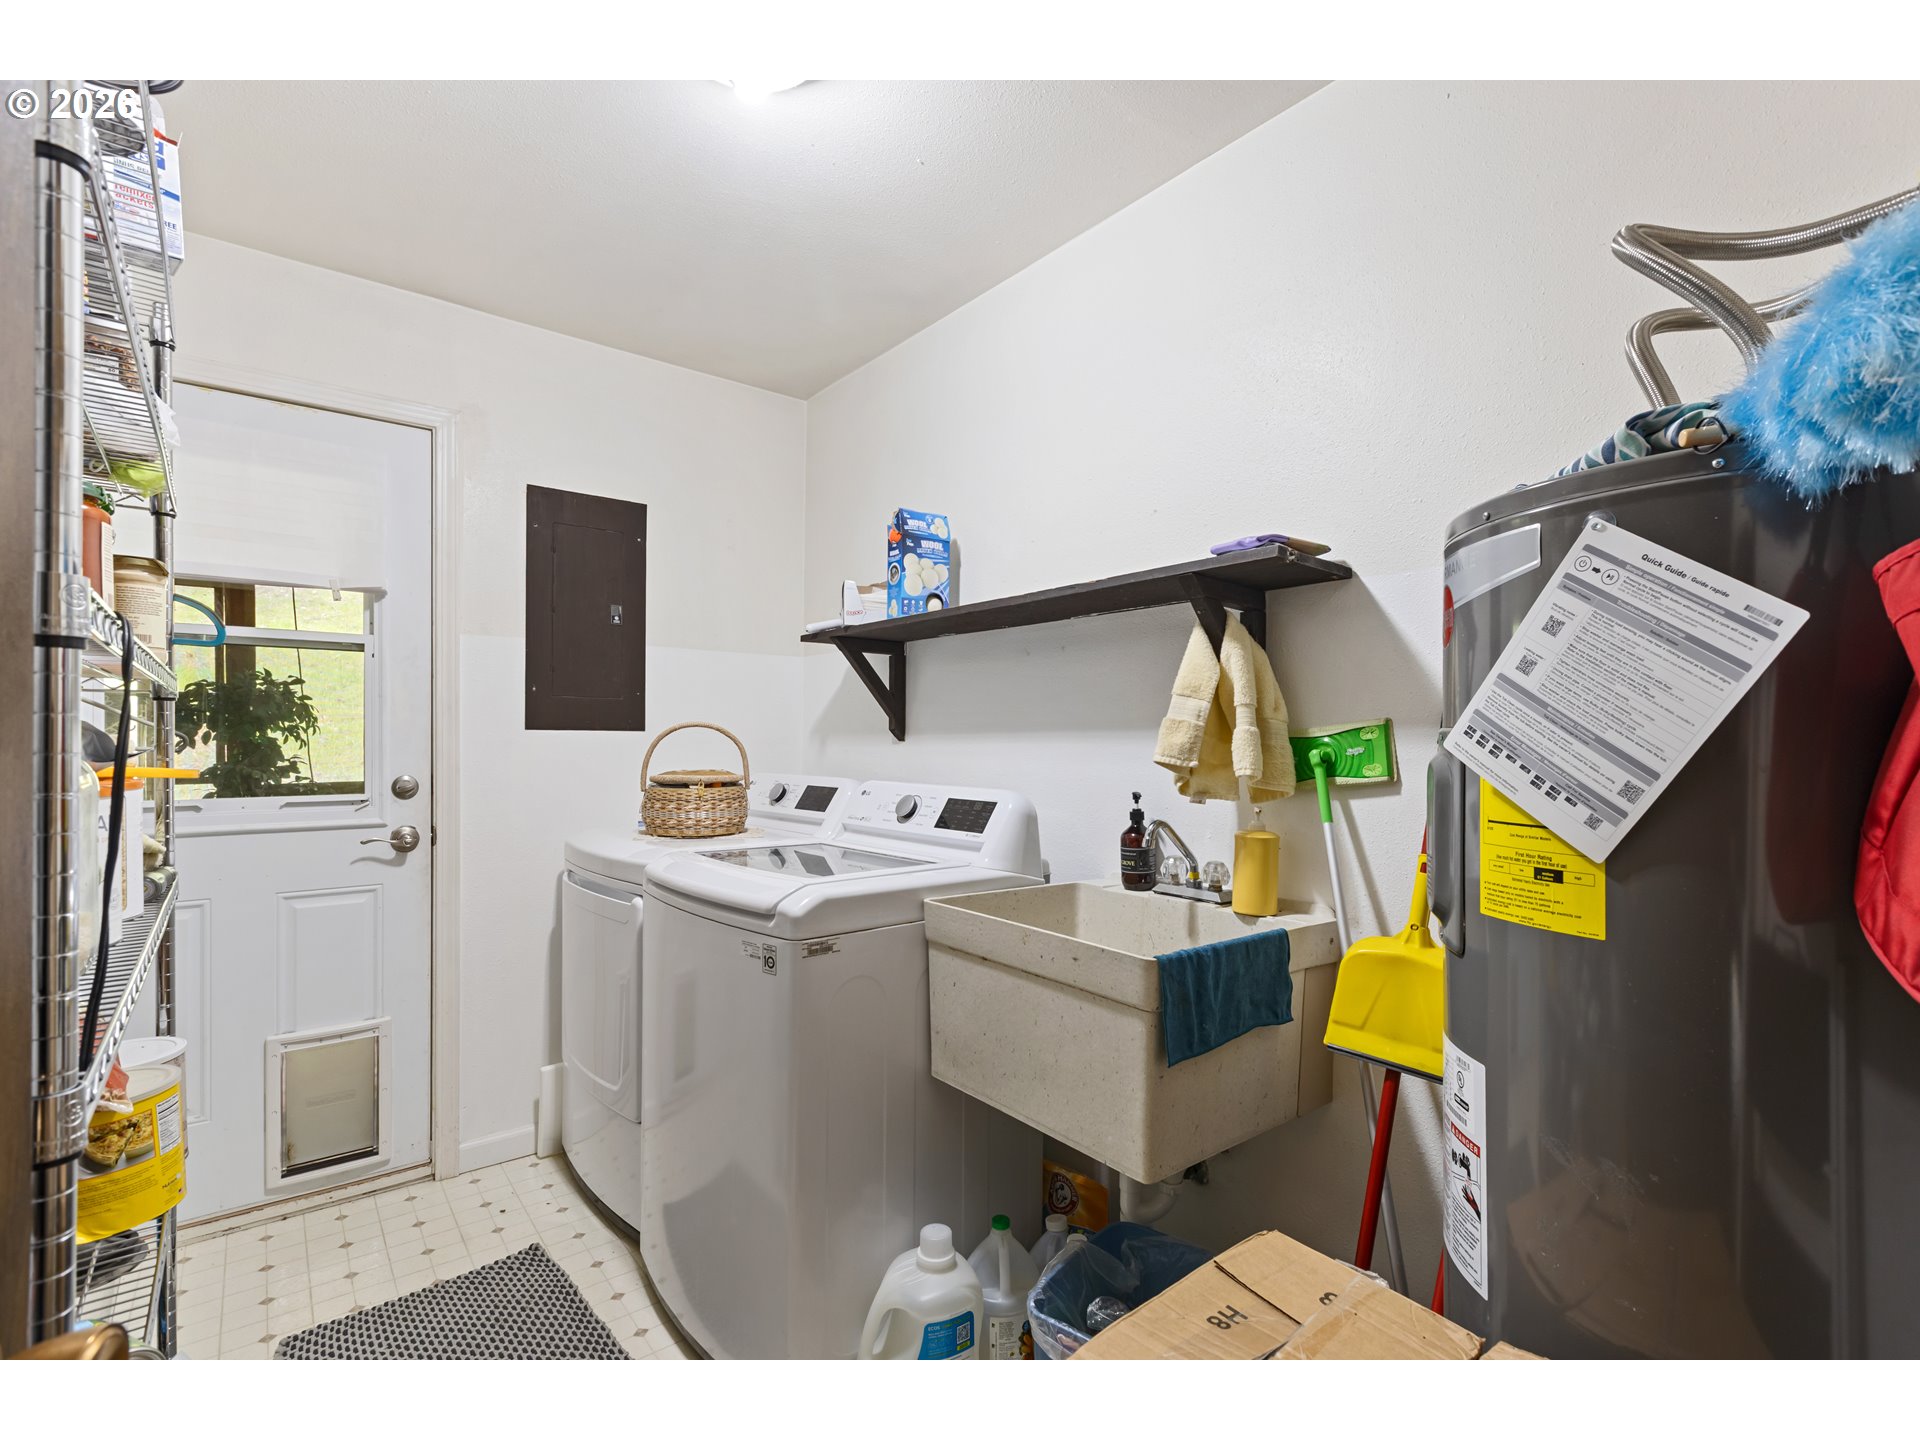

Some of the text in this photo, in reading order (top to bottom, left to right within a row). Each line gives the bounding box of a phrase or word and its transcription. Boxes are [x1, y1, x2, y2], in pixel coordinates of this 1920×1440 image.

[920, 540, 944, 550] WOOL
[1639, 552, 1665, 568] Quick
[1663, 563, 1689, 579] Guide
[1689, 576, 1710, 589] Guide
[1707, 584, 1731, 598] rapide
